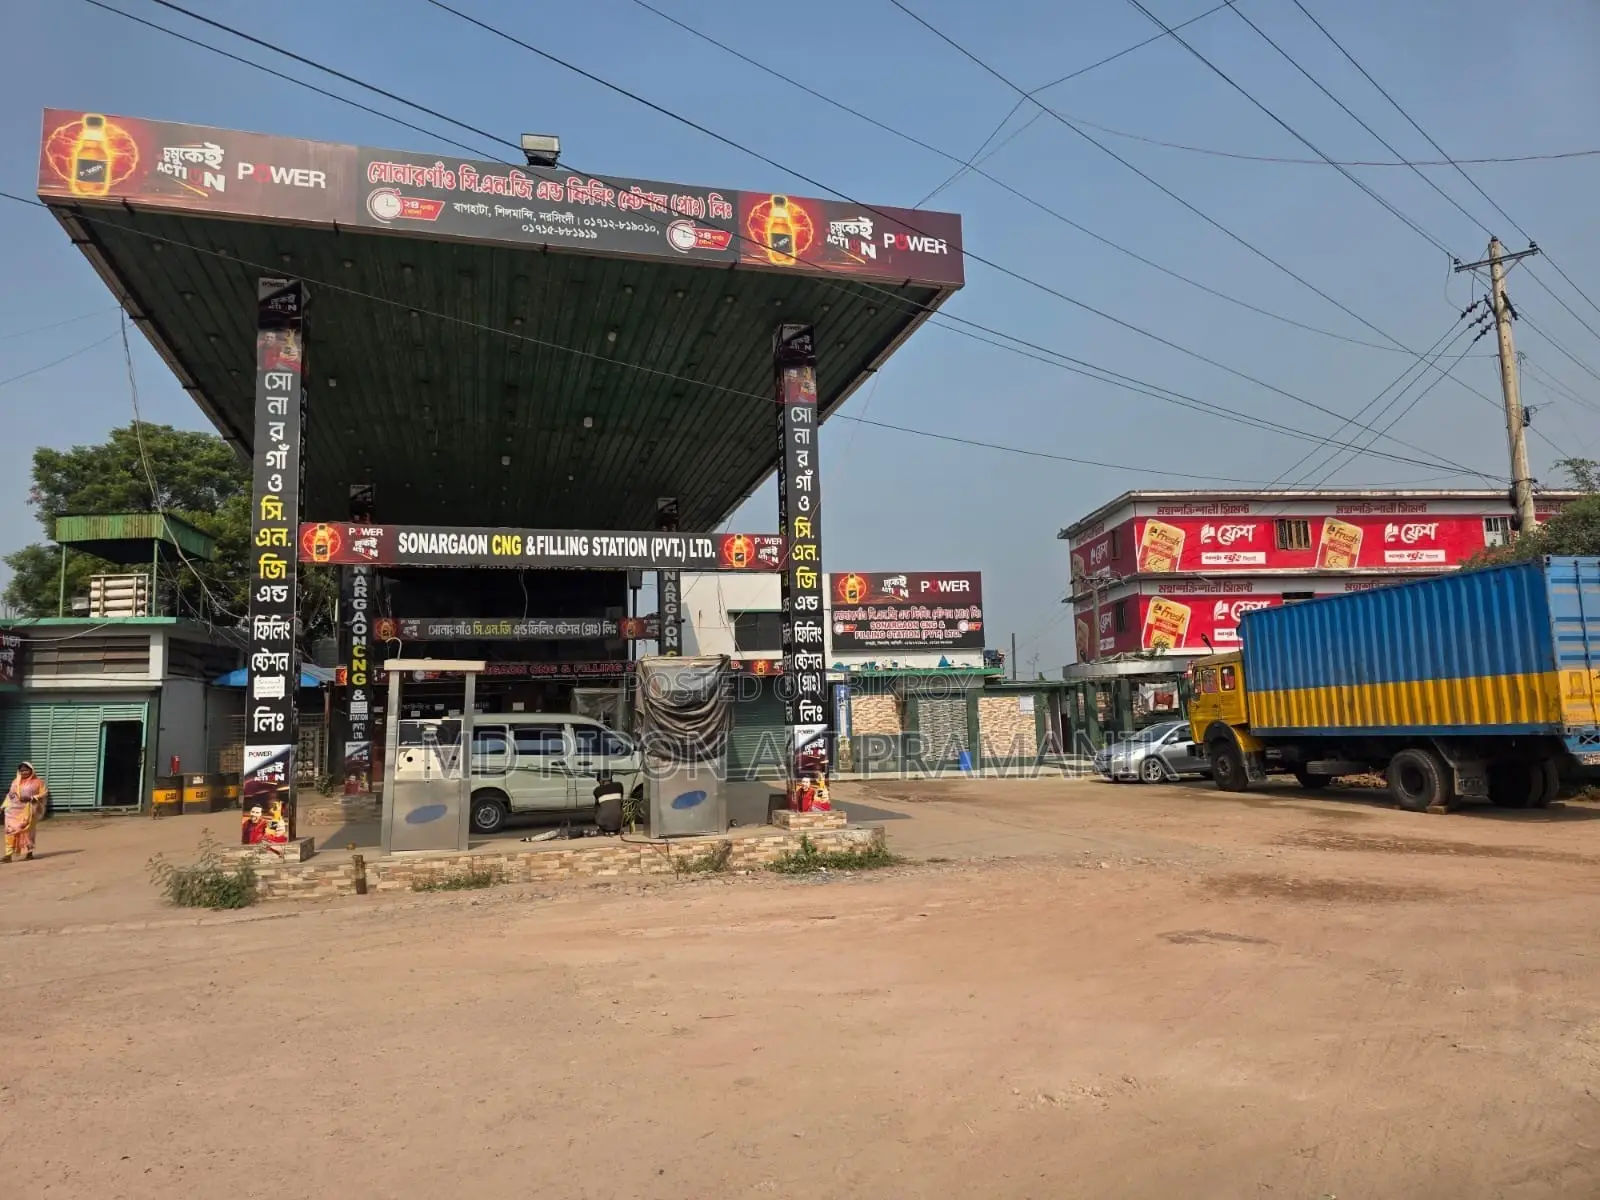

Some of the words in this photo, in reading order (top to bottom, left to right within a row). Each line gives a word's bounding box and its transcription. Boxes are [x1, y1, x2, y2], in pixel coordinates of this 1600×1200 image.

[157, 161, 225, 192] ACTION
[237, 162, 326, 188] POWER
[884, 232, 948, 254] POWER
[348, 528, 384, 536] POWER
[398, 532, 488, 555] SONARGAON
[492, 534, 522, 556] CNG
[592, 536, 648, 558] STATION
[650, 537, 686, 562] (PVT.)
[689, 539, 716, 559] LTD.
[920, 580, 970, 592] POWER
